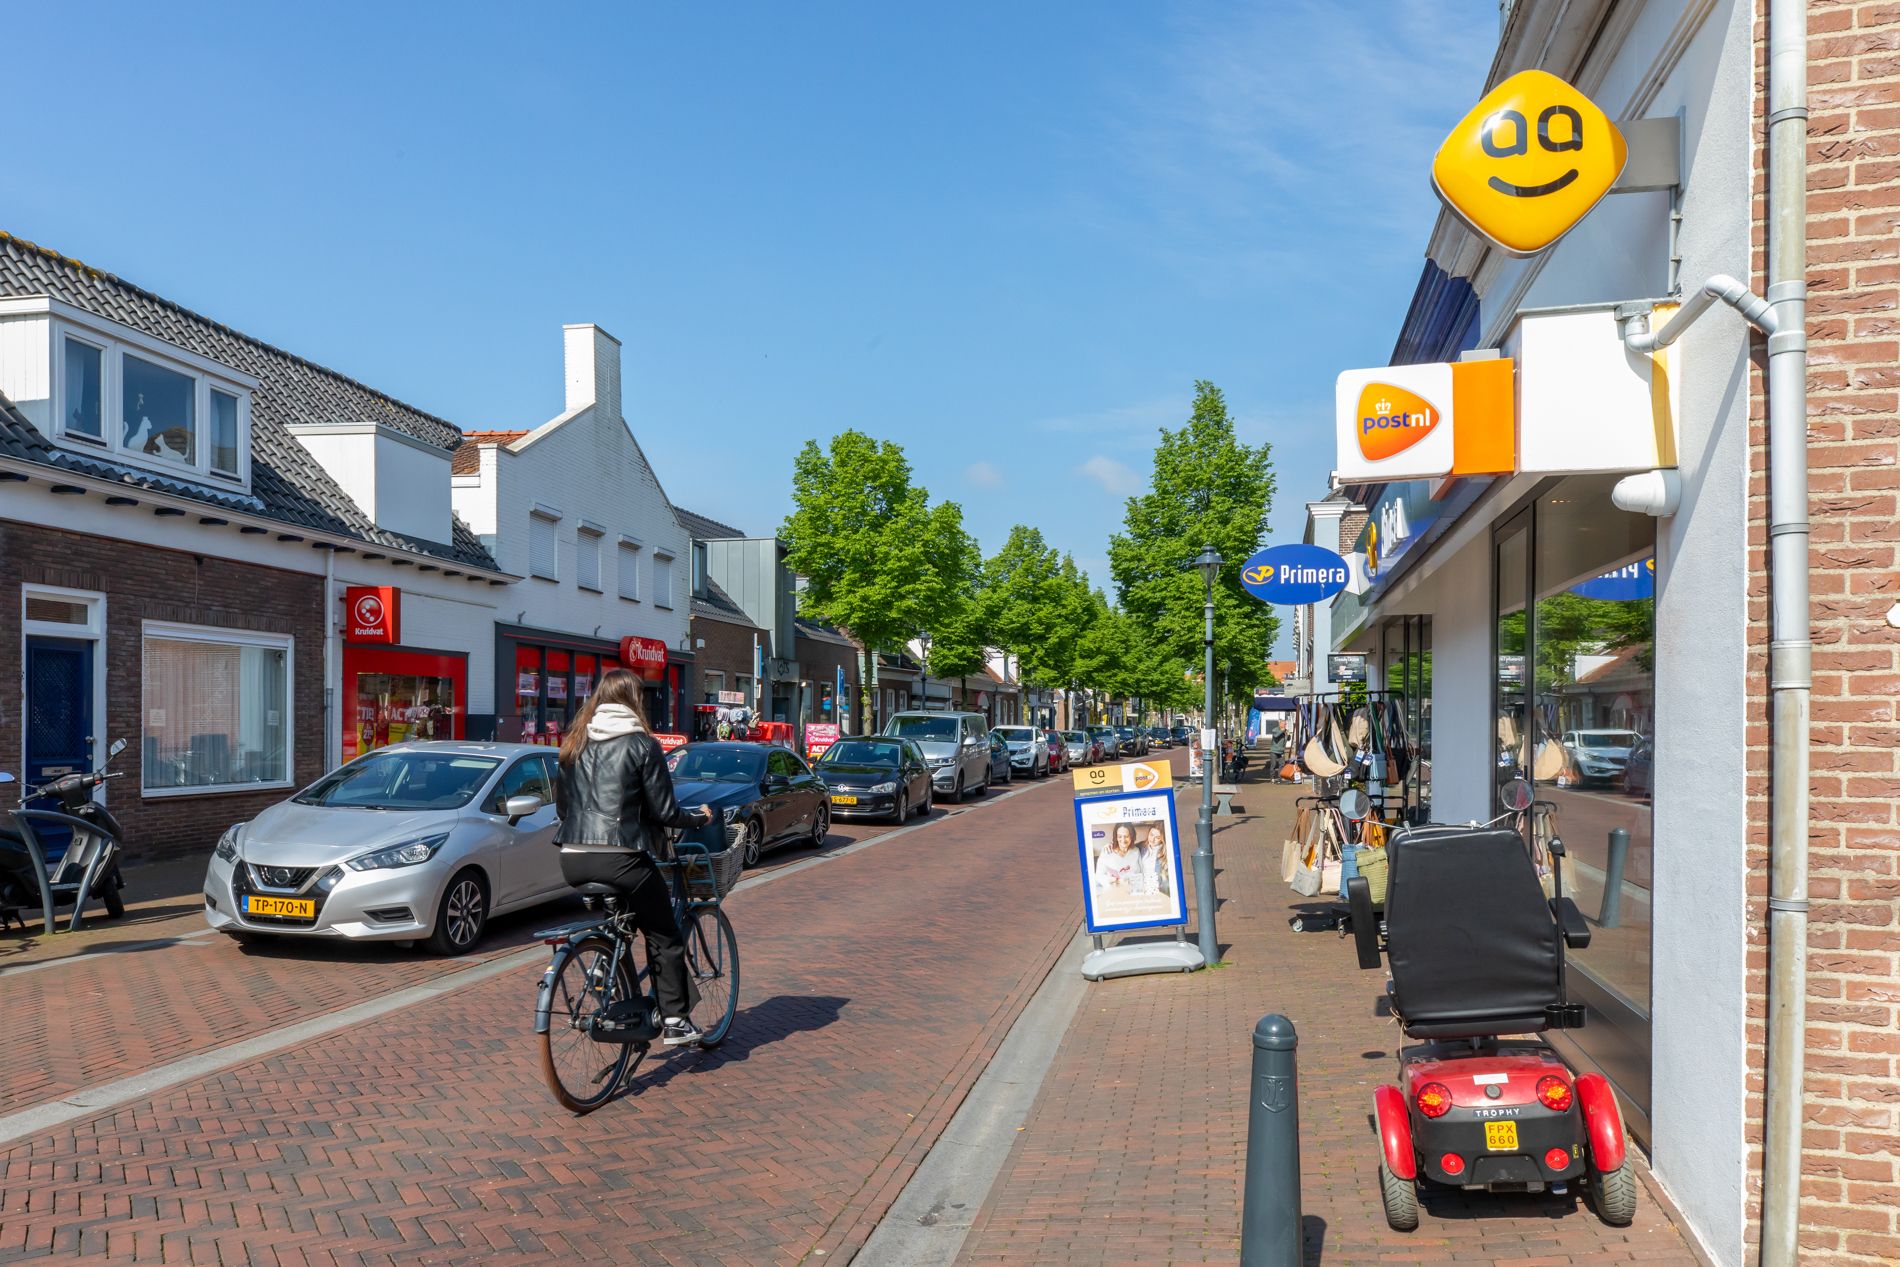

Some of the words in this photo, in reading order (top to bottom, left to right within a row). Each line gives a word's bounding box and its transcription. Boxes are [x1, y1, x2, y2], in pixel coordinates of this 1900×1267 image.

[1362, 409, 1430, 434] postnl
[1280, 564, 1345, 585] Primera
[637, 642, 665, 663] Kruidvat
[1123, 807, 1156, 817] Primera
[255, 899, 308, 914] TP-170-N
[1476, 1108, 1519, 1117] TROPHY
[1488, 1125, 1514, 1133] FPX
[1489, 1136, 1514, 1144] 660
